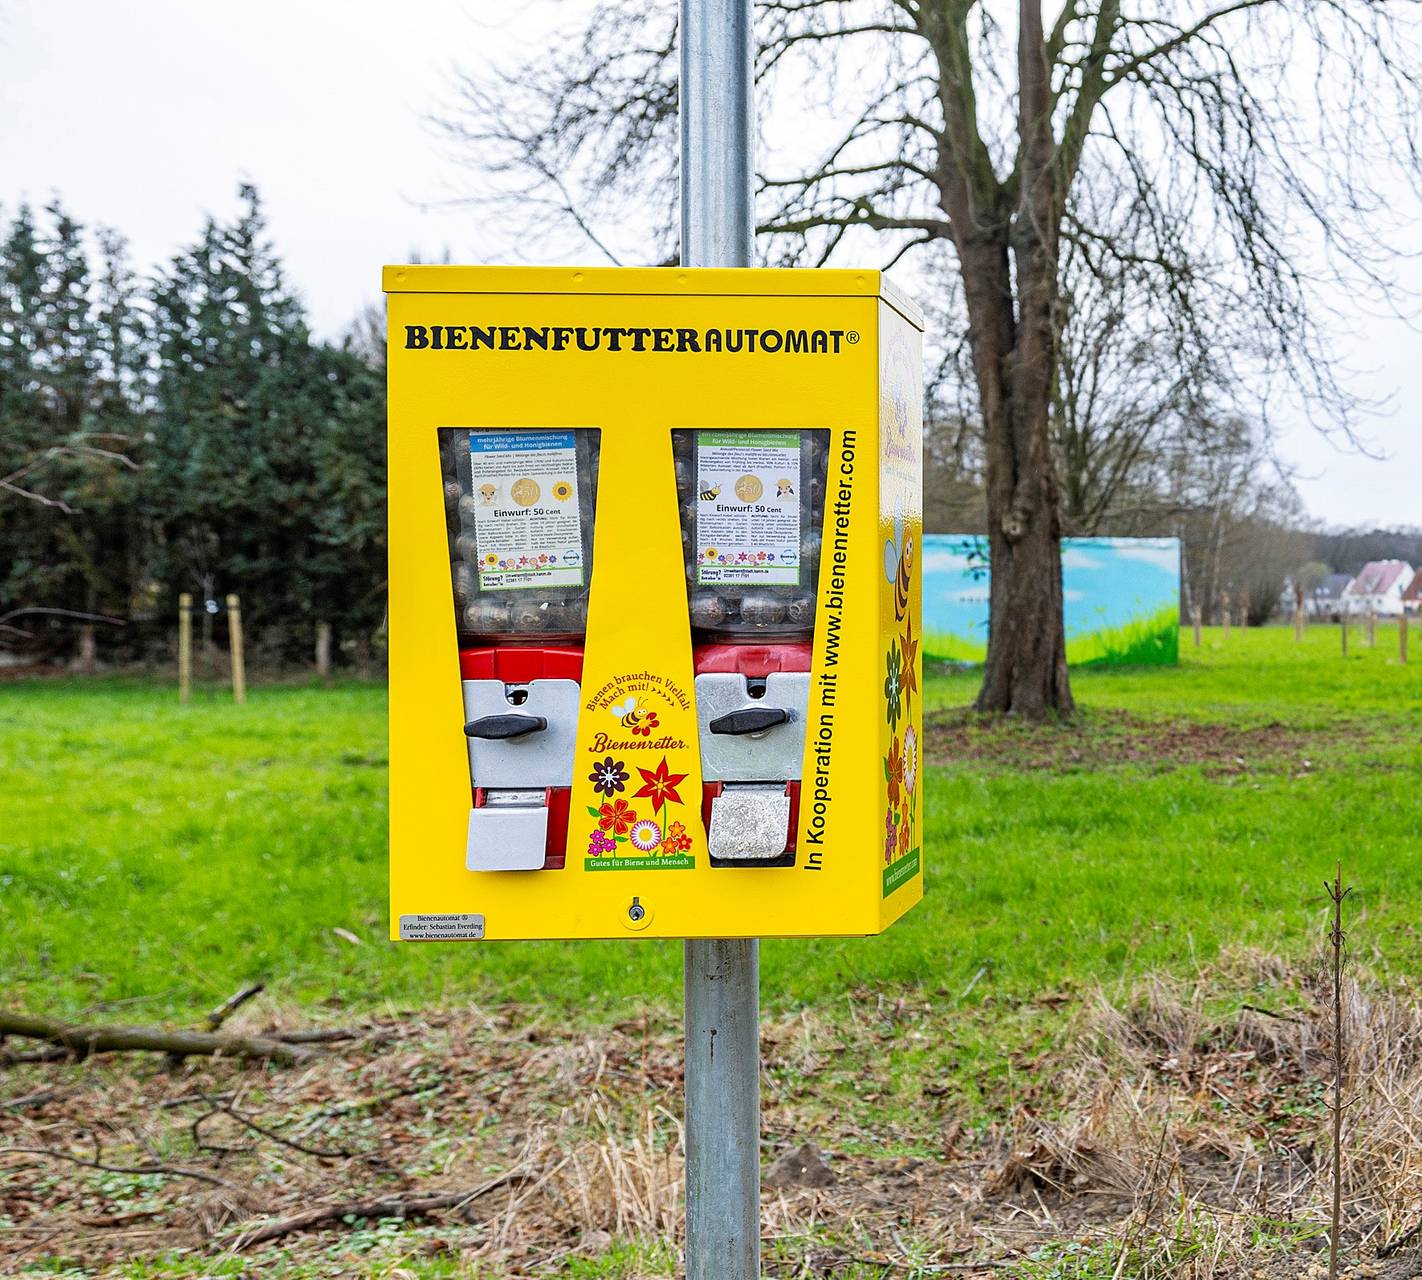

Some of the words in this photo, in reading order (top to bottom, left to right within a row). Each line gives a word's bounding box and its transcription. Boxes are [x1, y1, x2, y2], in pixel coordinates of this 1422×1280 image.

[494, 509, 532, 517] Einwurf:
[825, 430, 856, 666] www.bienenretter.com
[586, 682, 614, 712] Bienen
[614, 671, 662, 685] brauchen
[664, 679, 690, 711] Vielfalt
[599, 687, 626, 710] Mach
[628, 682, 649, 692] mit!
[819, 674, 837, 707] mit
[588, 732, 686, 753] Bienenretter
[806, 714, 834, 844] Kooperation
[804, 852, 822, 870] In
